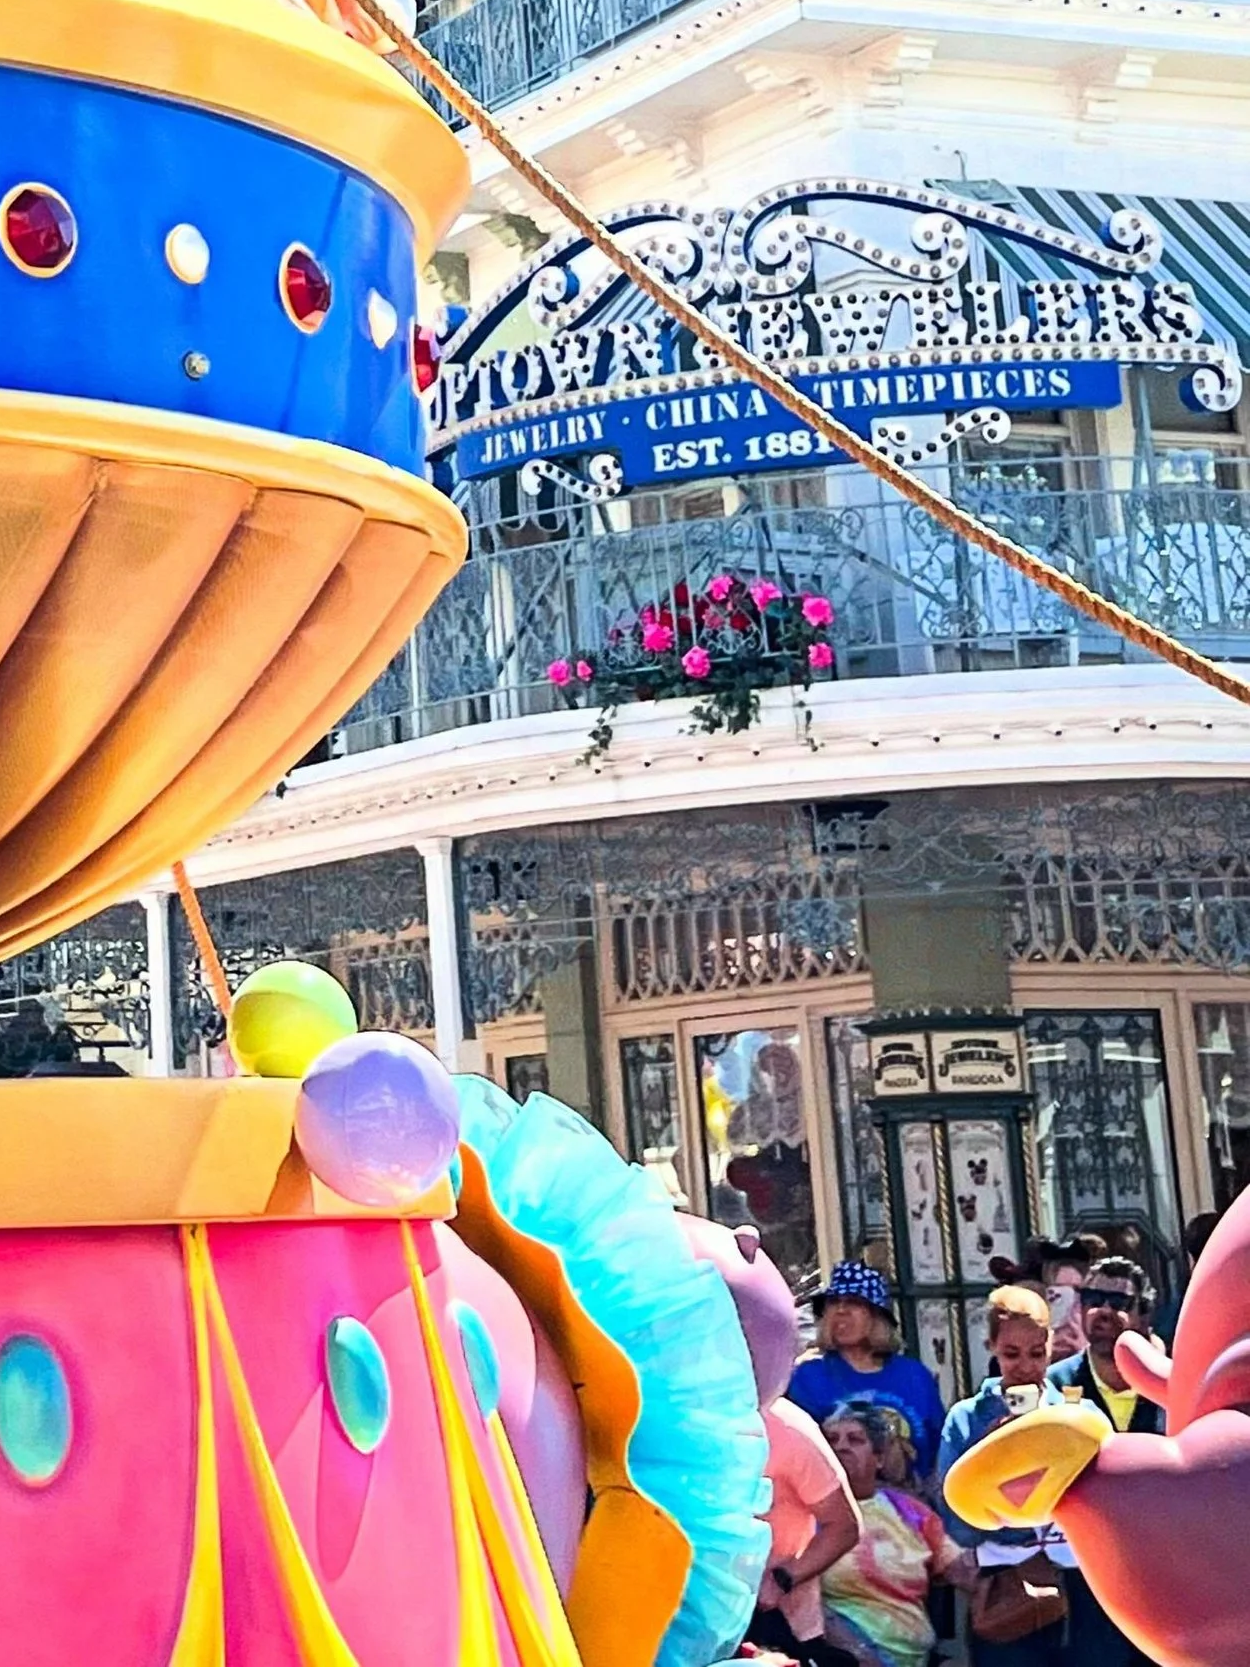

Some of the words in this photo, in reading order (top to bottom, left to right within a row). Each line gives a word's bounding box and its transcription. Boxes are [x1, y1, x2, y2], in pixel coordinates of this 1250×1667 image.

[692, 280, 1203, 368] JEWELERS
[480, 411, 606, 464] JEWELRY
[645, 388, 768, 430] CHINA
[813, 367, 1072, 410] TIMEPIECES
[652, 437, 732, 472] EST.
